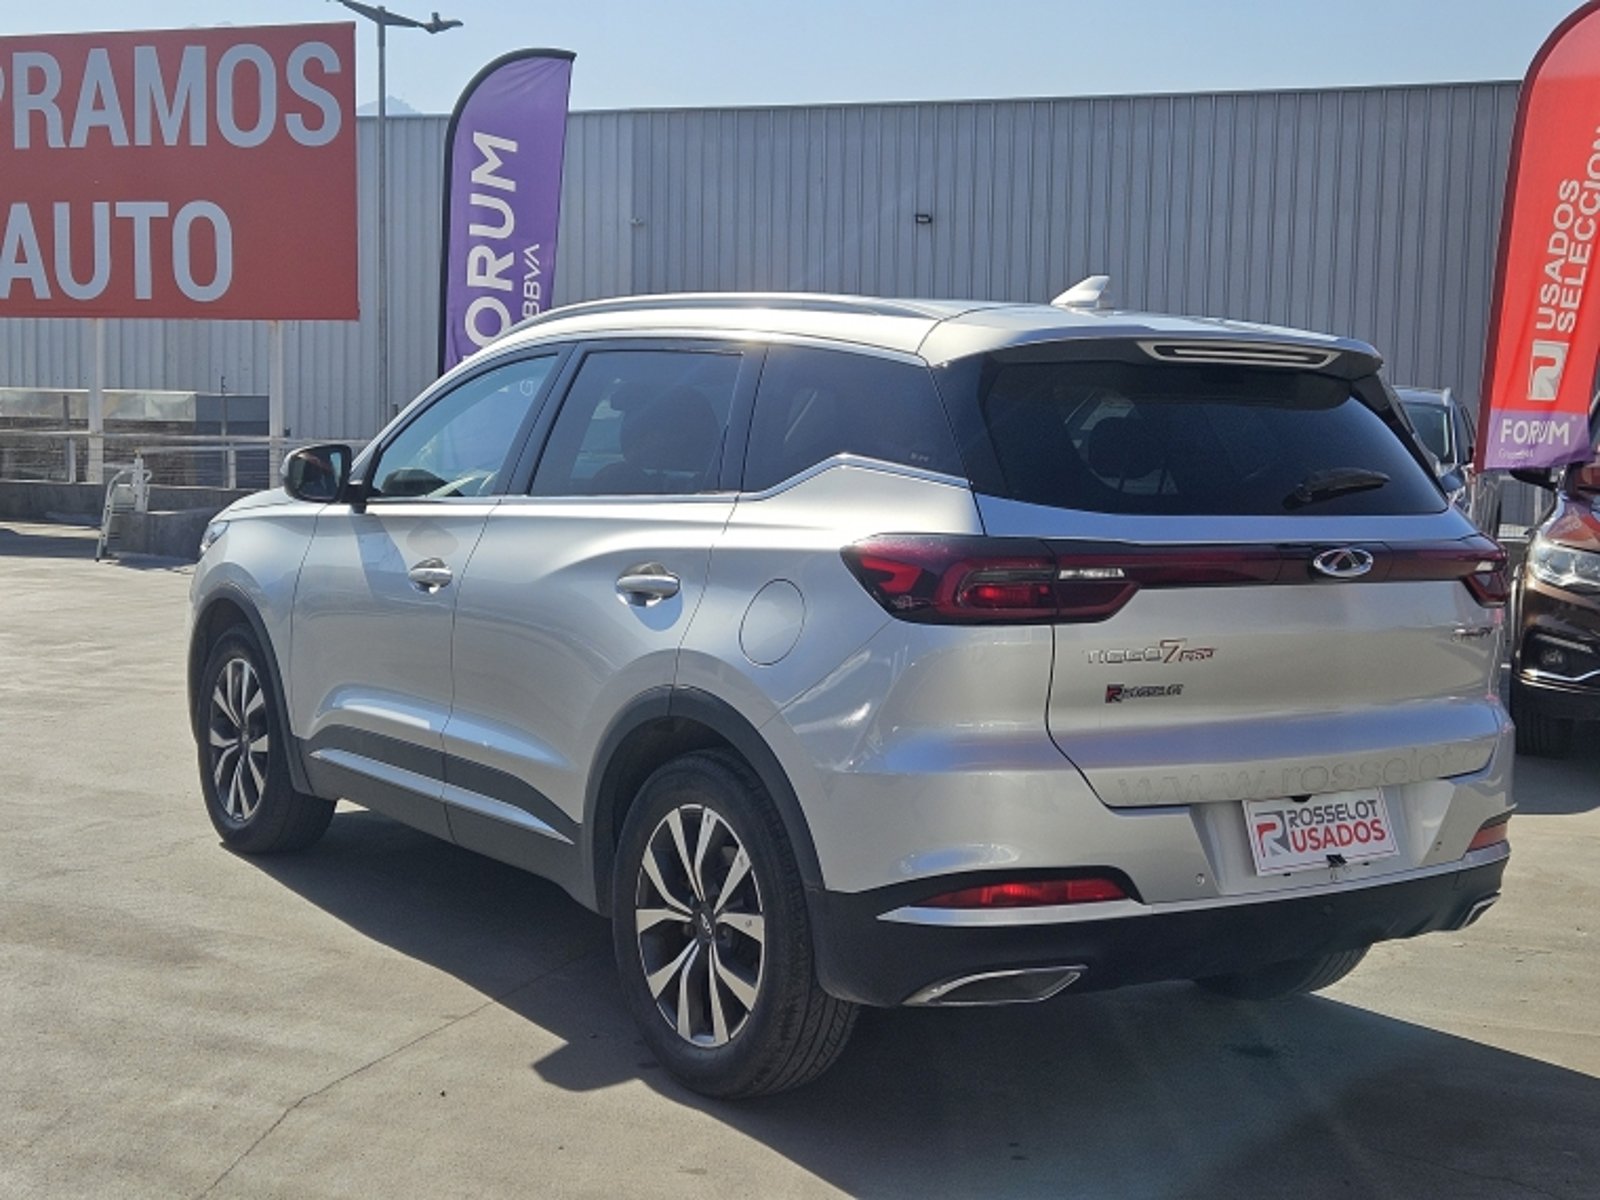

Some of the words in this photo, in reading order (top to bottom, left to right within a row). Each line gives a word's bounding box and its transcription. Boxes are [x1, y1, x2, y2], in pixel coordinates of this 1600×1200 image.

[0, 41, 342, 149] RAMOS
[0, 200, 233, 302] AUTO
[463, 131, 519, 361] ORUM
[1536, 178, 1580, 330] USADOS
[1500, 418, 1570, 446] FORUM
[1286, 799, 1378, 828] ROSSELOT
[1290, 818, 1387, 853] USADOS
